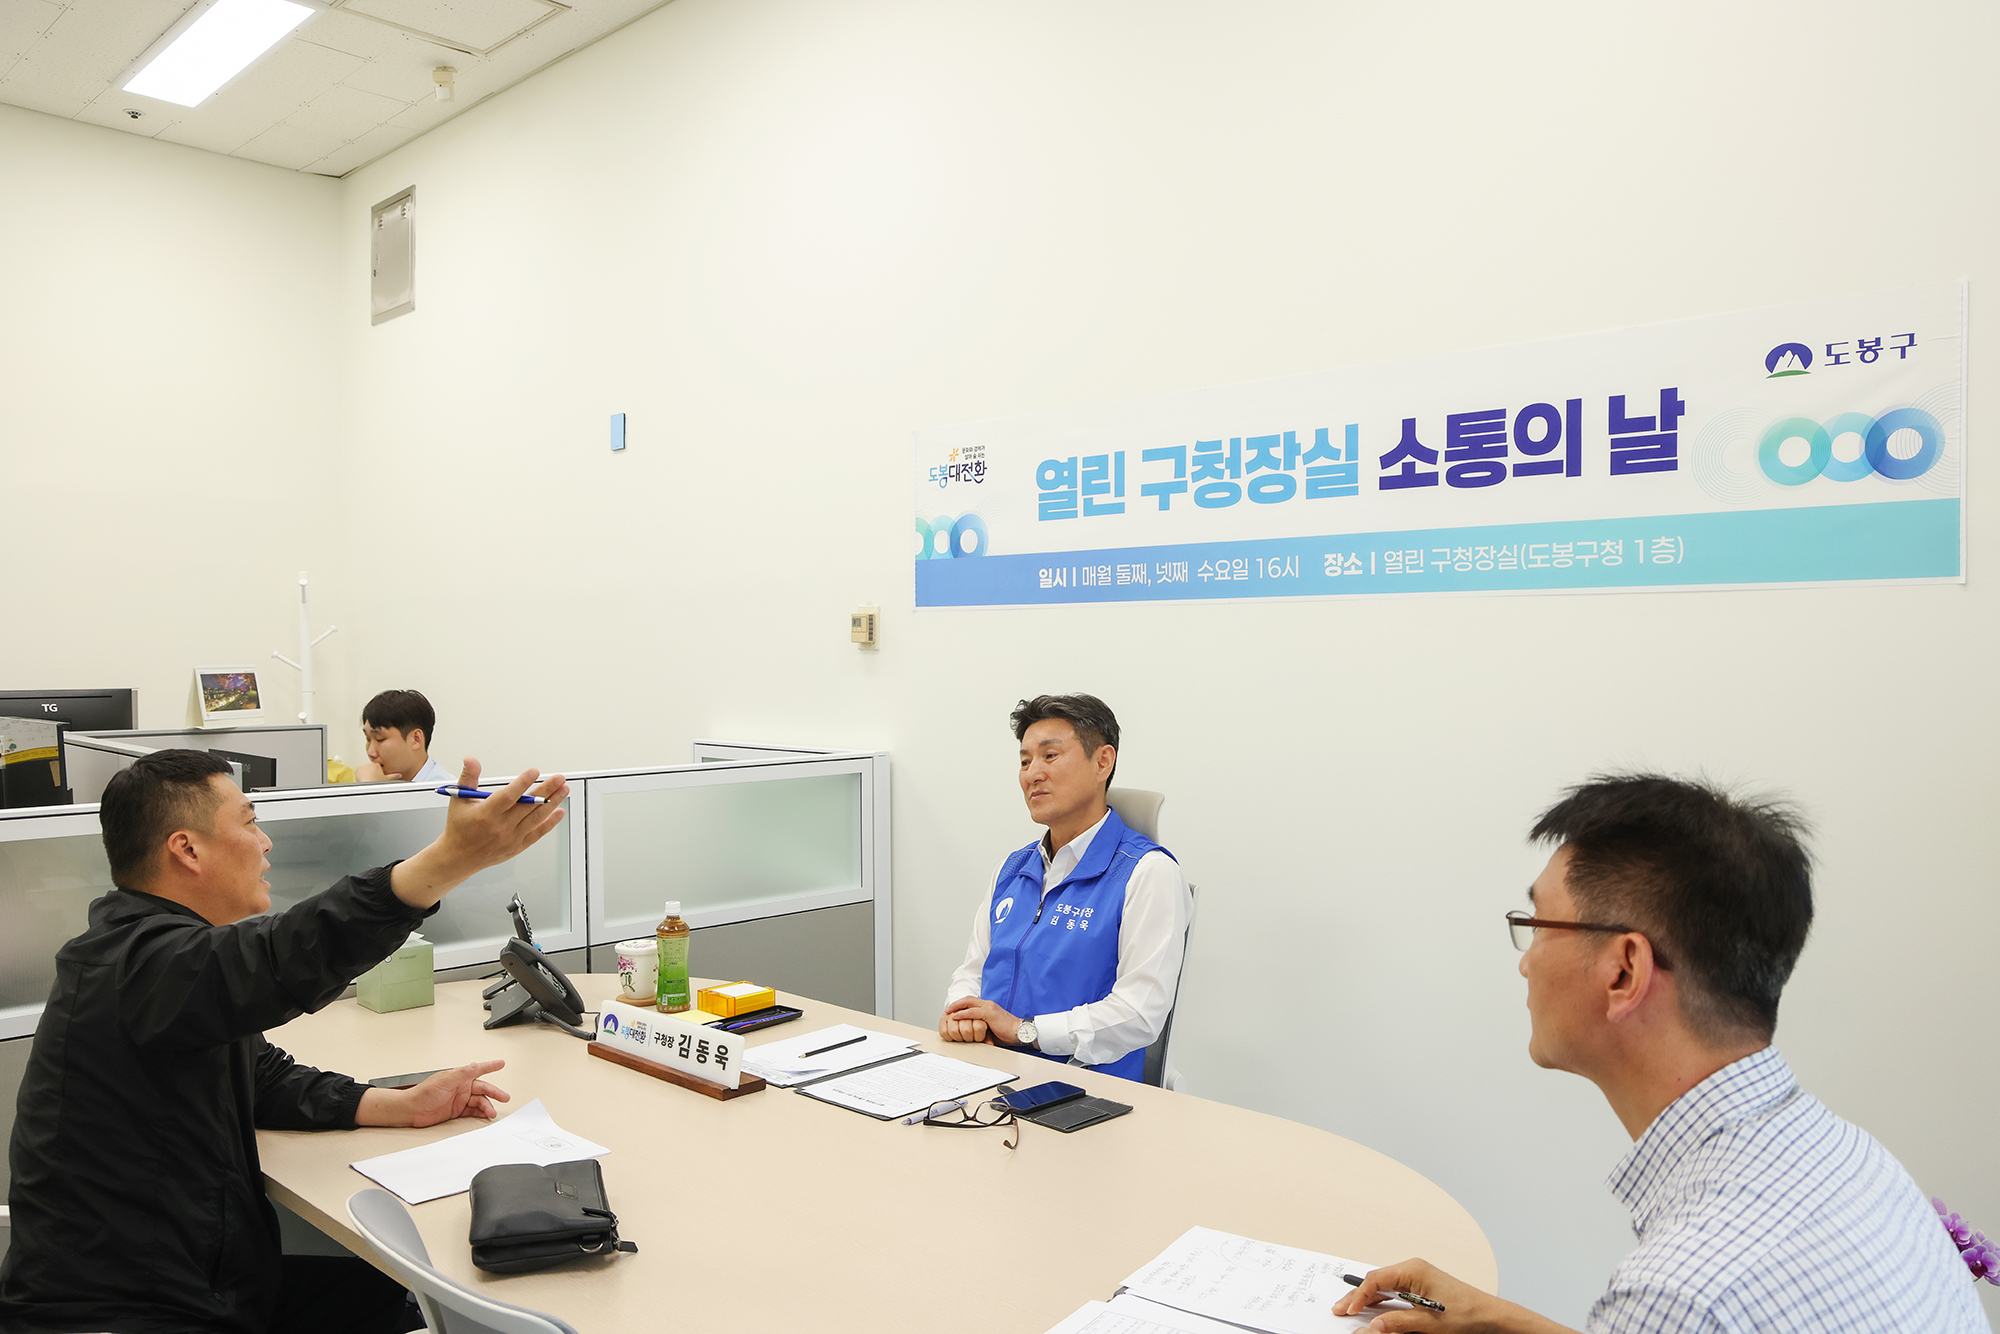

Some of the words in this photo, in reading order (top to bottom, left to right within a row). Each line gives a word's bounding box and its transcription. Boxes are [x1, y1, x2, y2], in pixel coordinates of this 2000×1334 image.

[1824, 332, 1919, 367] 도봉구
[1036, 450, 1126, 522] 열린
[1140, 423, 1359, 511] 구청장실
[1379, 397, 1582, 491] 소통의
[1608, 387, 1685, 477] 날
[928, 459, 988, 489] 도봉대전환
[1038, 567, 1067, 589] 일시
[1082, 564, 1112, 587] 매월
[1116, 563, 1152, 587] 둘째,
[1156, 561, 1189, 584] 넷째
[1197, 557, 1249, 583] 수요일
[1256, 555, 1300, 579] 16시
[1323, 552, 1364, 577] 장소
[1383, 549, 1425, 575] 열린
[1431, 539, 1624, 574] 구청장실(도봉구청
[1634, 536, 1685, 565] 1층)
[41, 703, 58, 713] TG
[653, 1031, 675, 1049] 구청장
